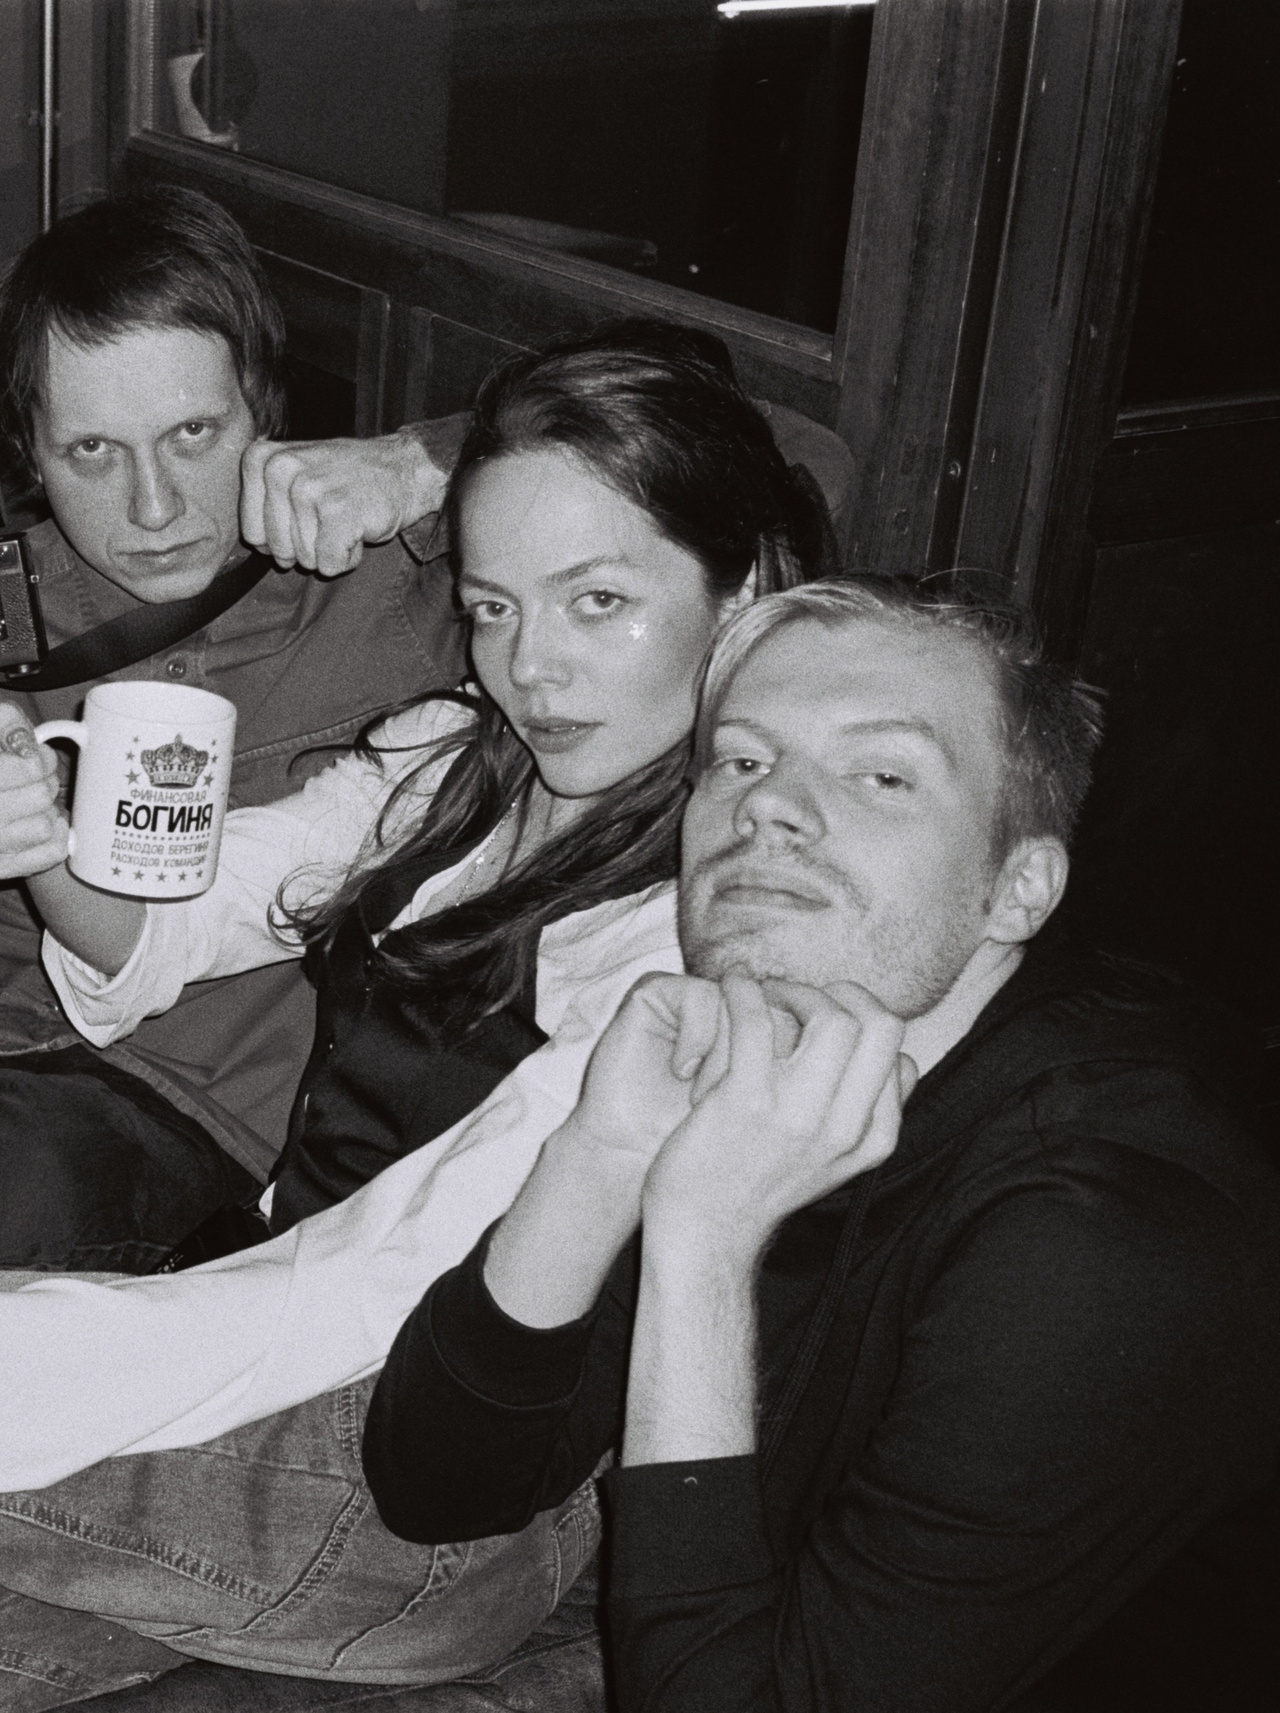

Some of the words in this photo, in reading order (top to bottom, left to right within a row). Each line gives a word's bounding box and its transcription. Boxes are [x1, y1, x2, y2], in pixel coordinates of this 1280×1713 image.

[130, 788, 207, 803] ФИНАНСОВАЯ
[116, 800, 213, 832] БОГИНЯ
[111, 838, 165, 855] ДОХОДОВ
[110, 851, 161, 867] РАСХОДОВ
